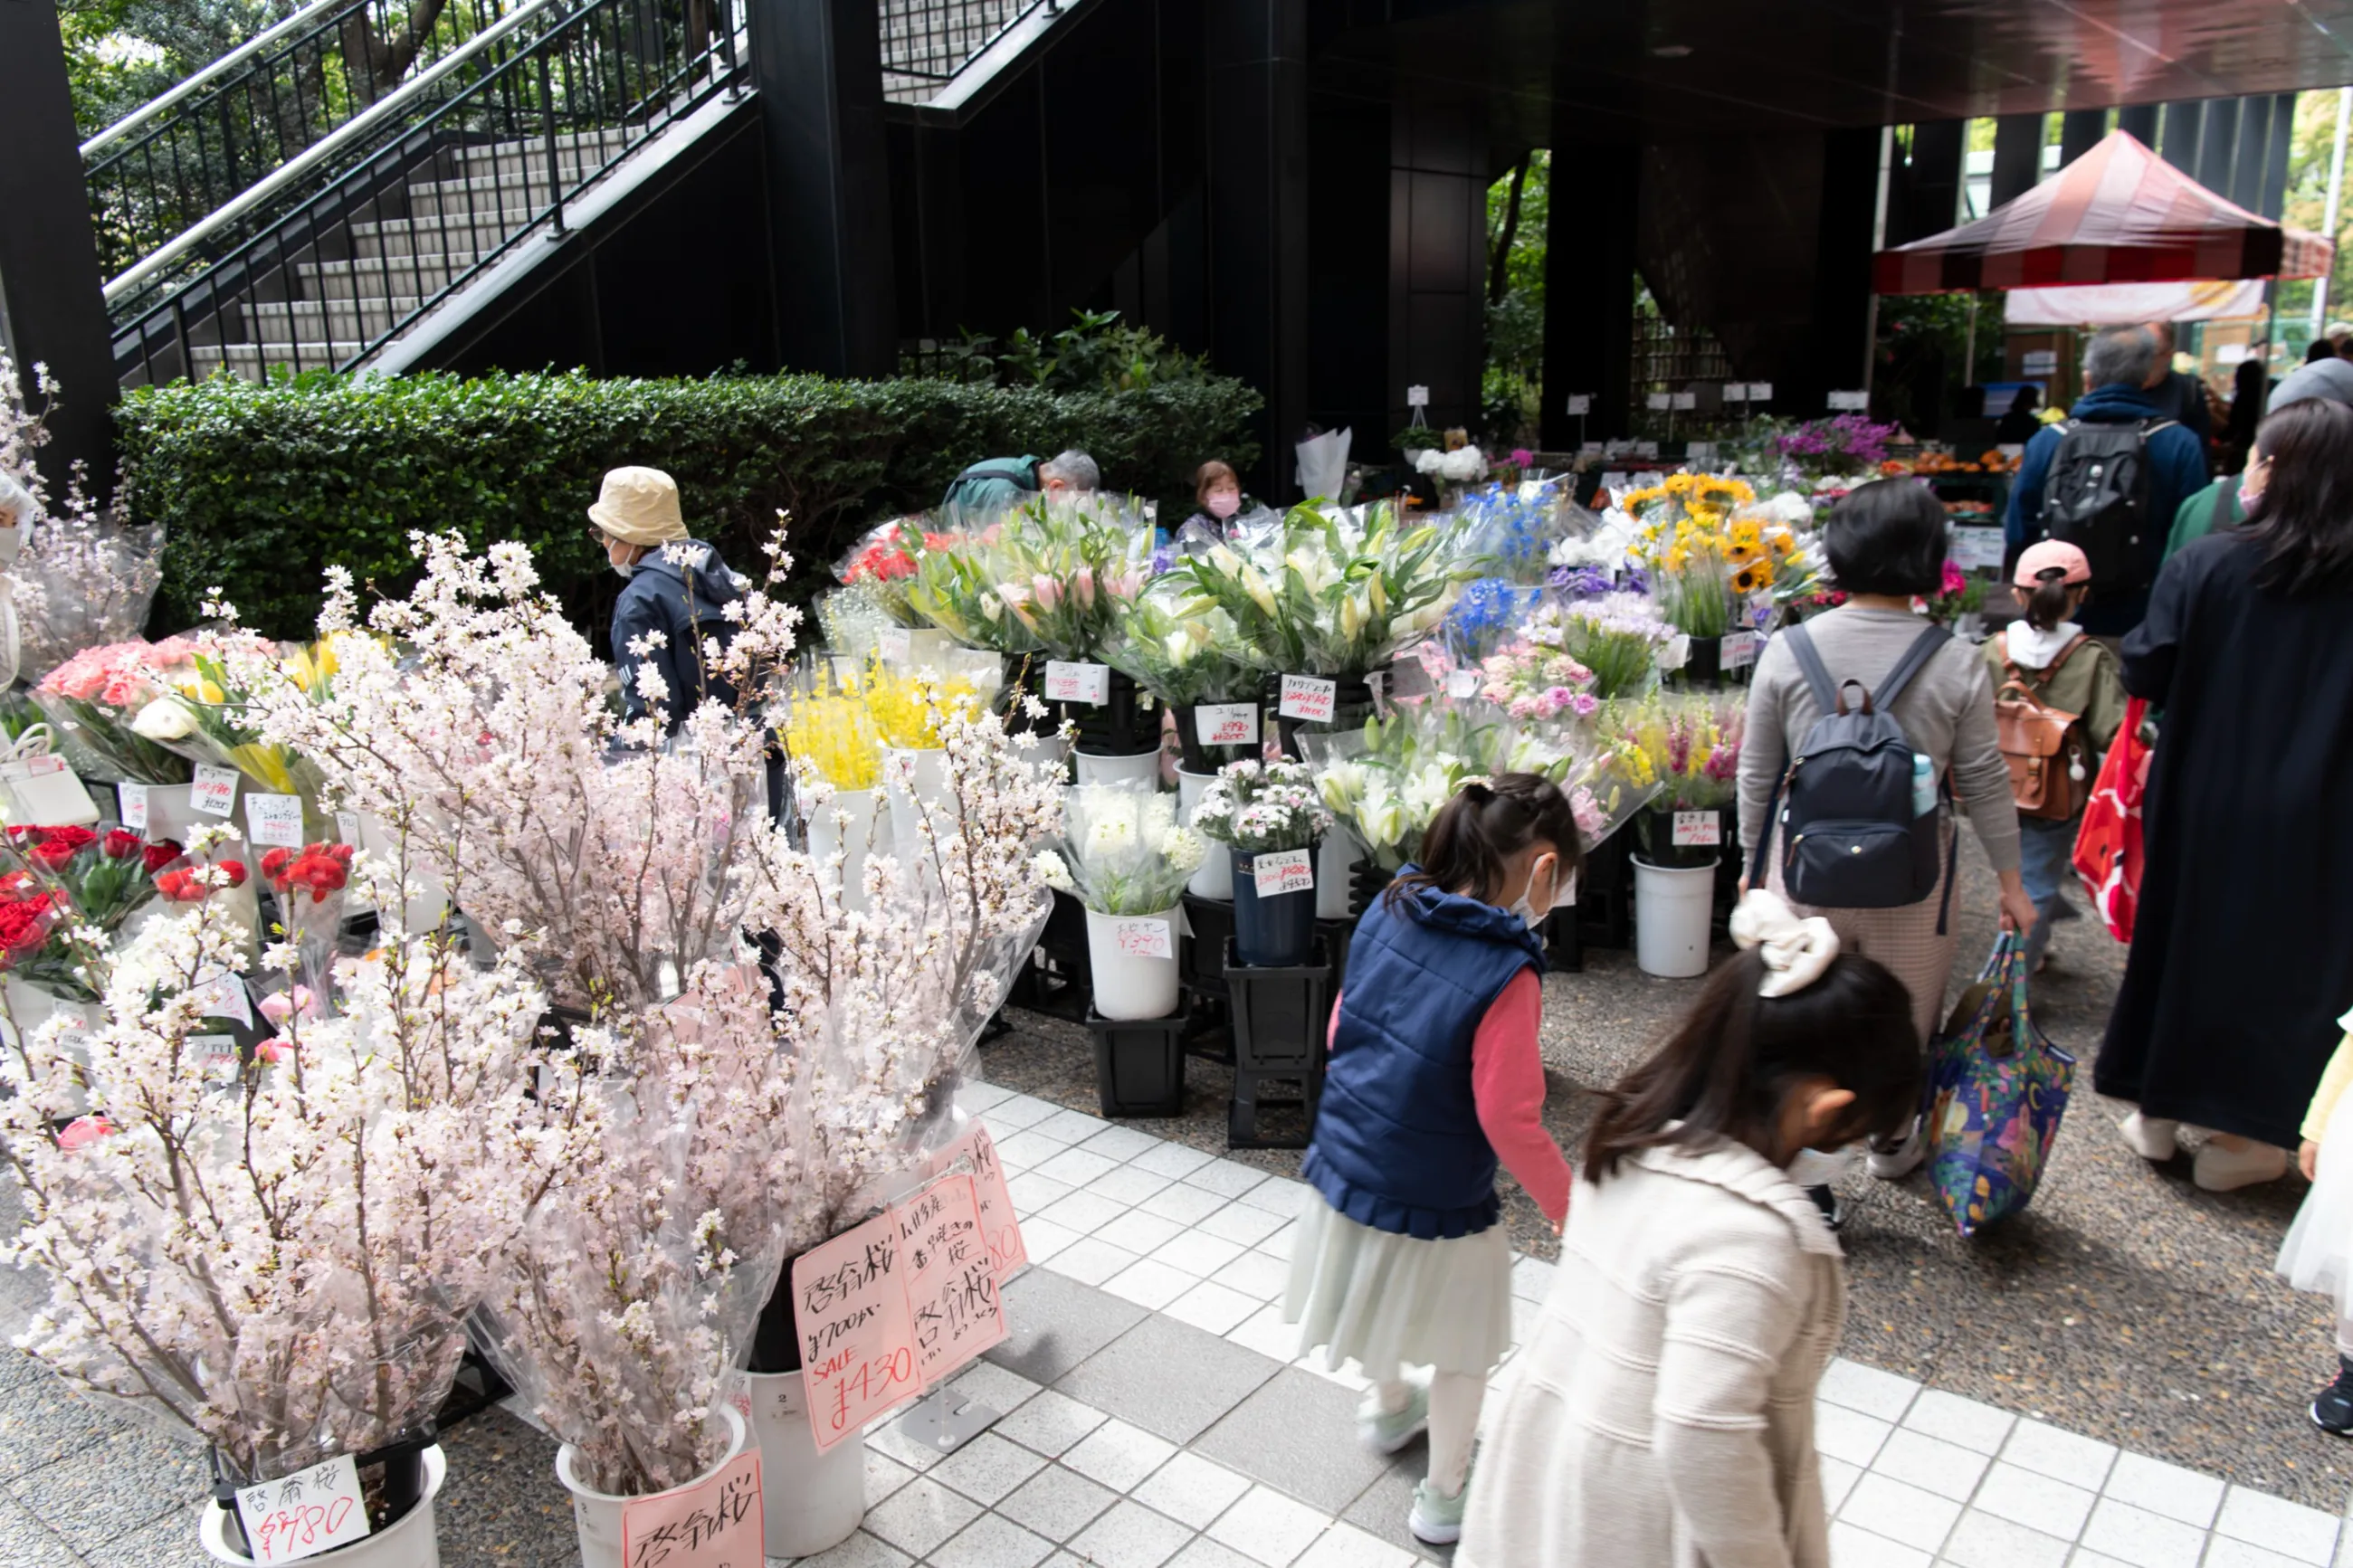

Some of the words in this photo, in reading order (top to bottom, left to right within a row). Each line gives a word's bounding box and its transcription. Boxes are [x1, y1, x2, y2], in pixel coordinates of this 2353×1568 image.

[811, 1344, 859, 1387] SALE
[777, 1393, 787, 1403] 2
[831, 1346, 911, 1430] ¥430
